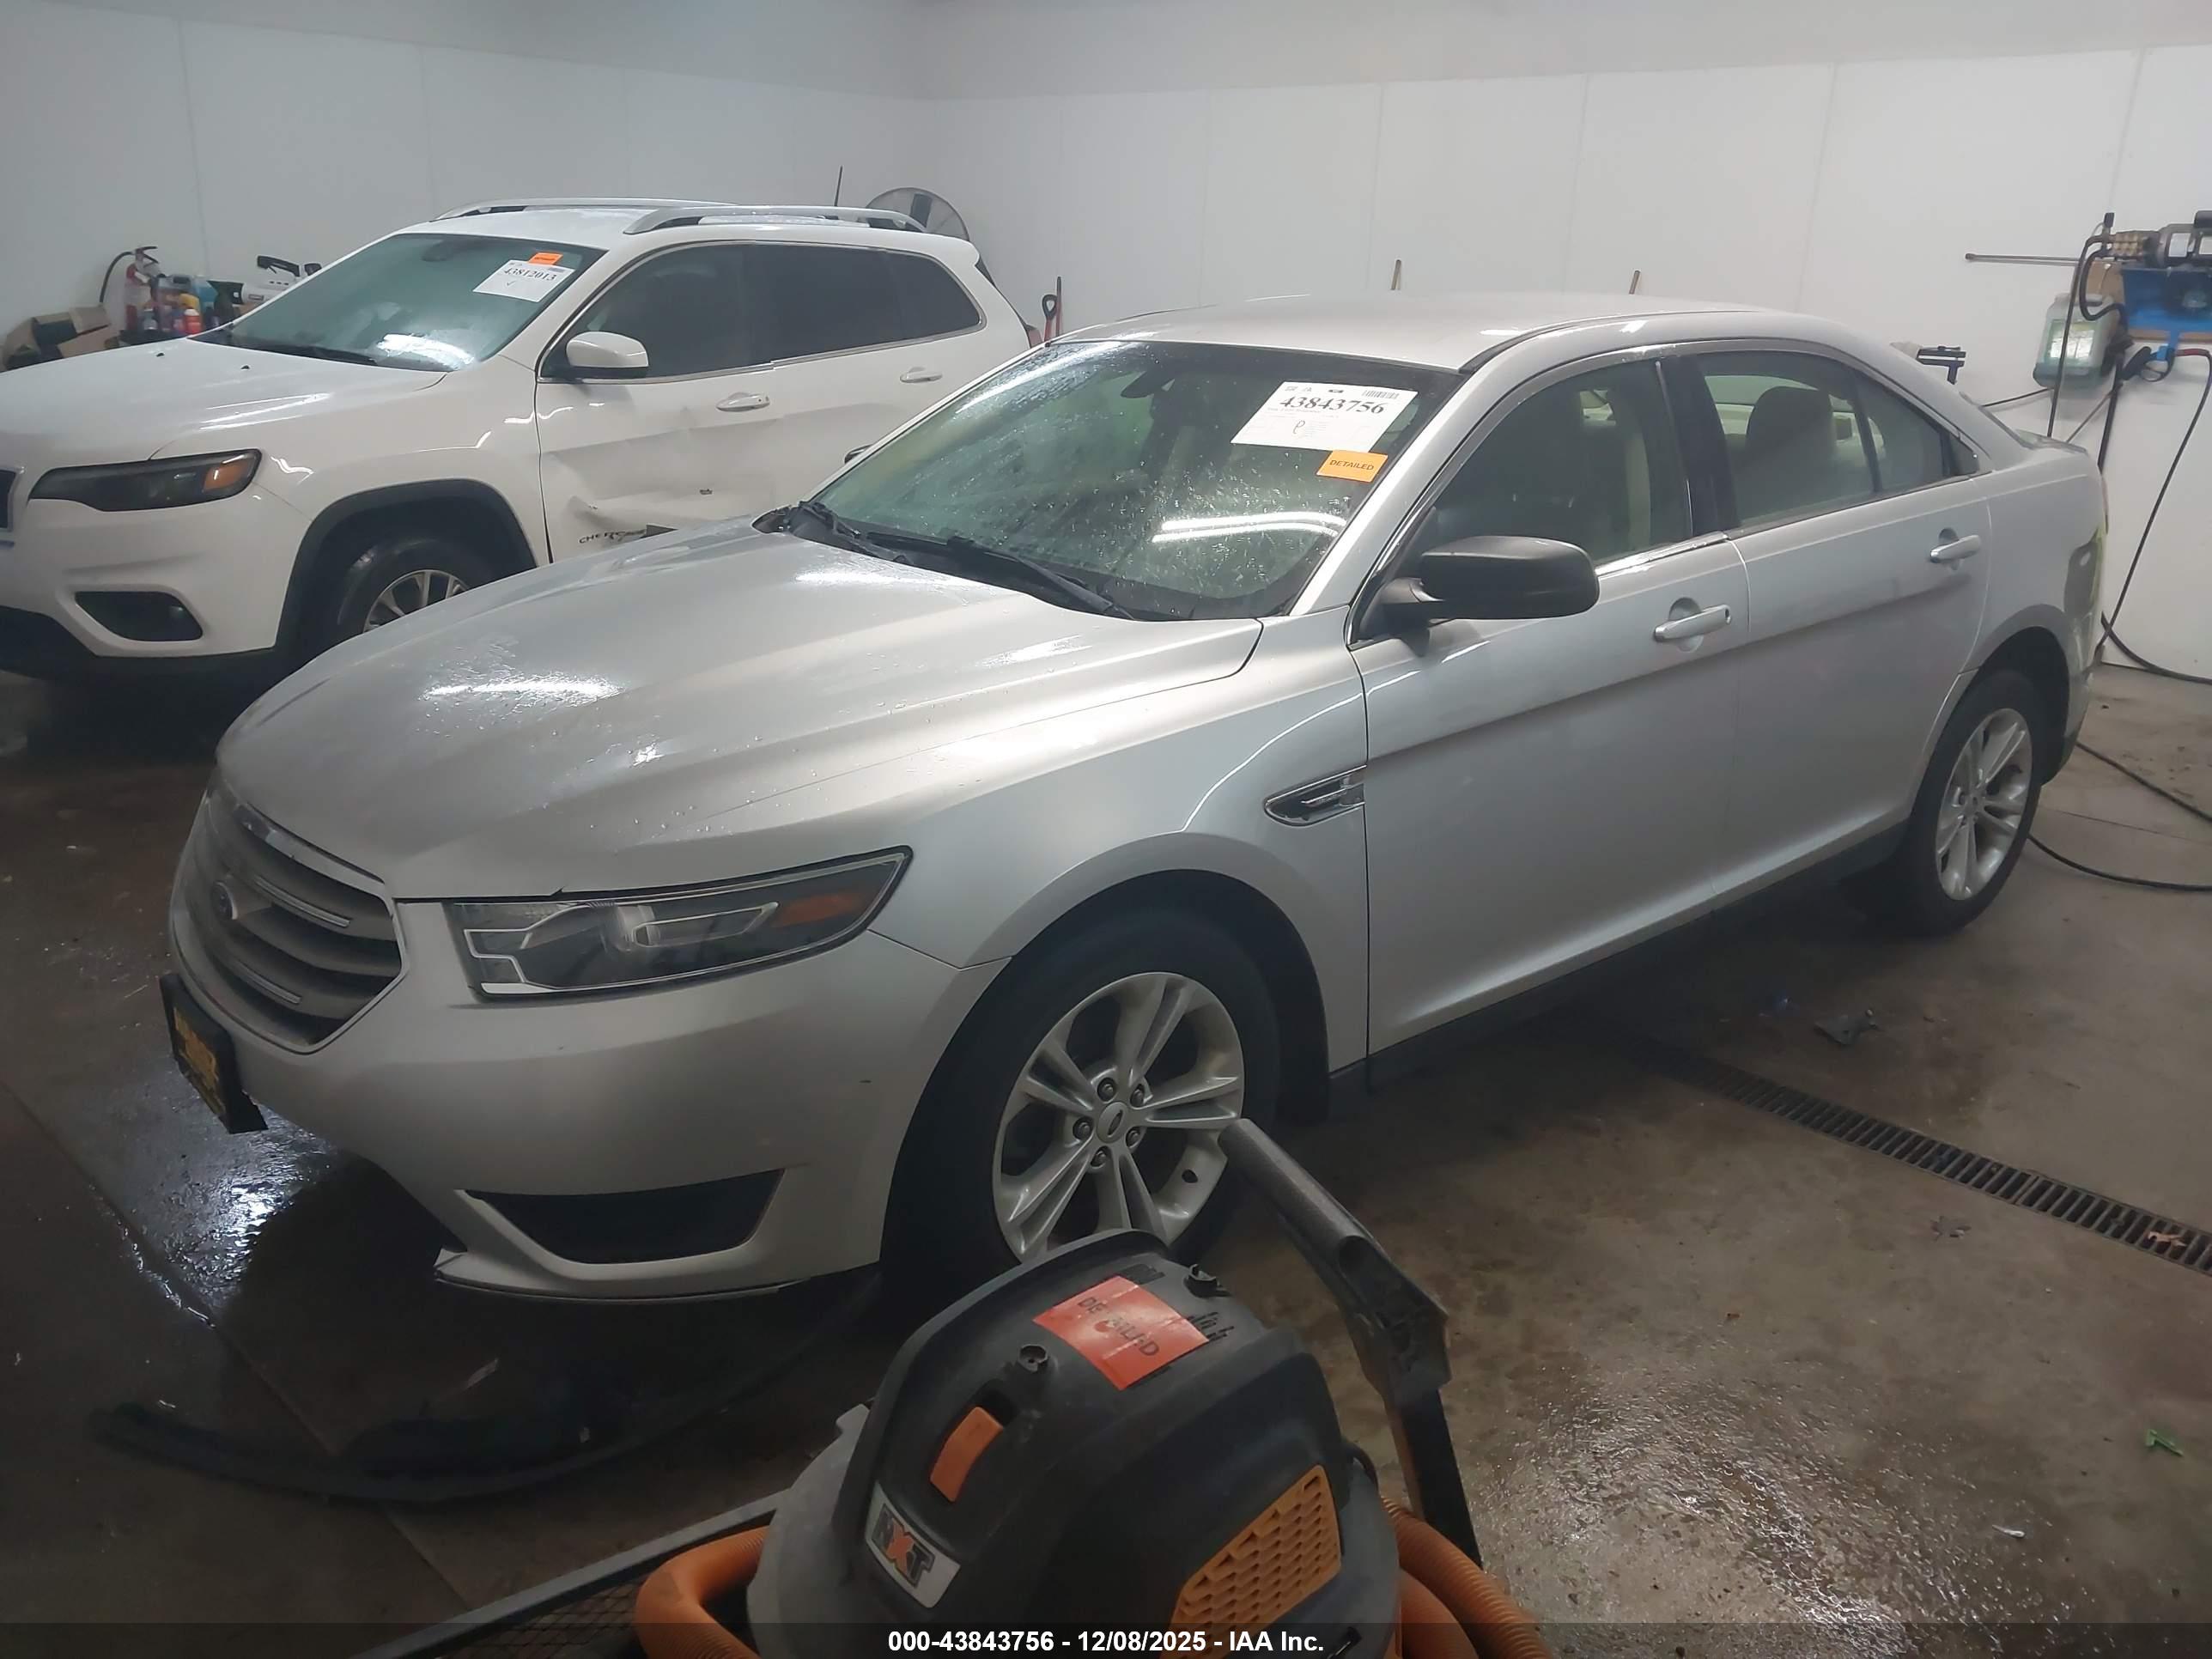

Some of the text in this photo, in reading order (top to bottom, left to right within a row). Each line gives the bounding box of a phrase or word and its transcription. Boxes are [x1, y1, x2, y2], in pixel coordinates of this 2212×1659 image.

[1279, 395, 1389, 415] 43843756
[1328, 459, 1375, 471] DETAILED
[1077, 1297, 1159, 1357] DEAILED
